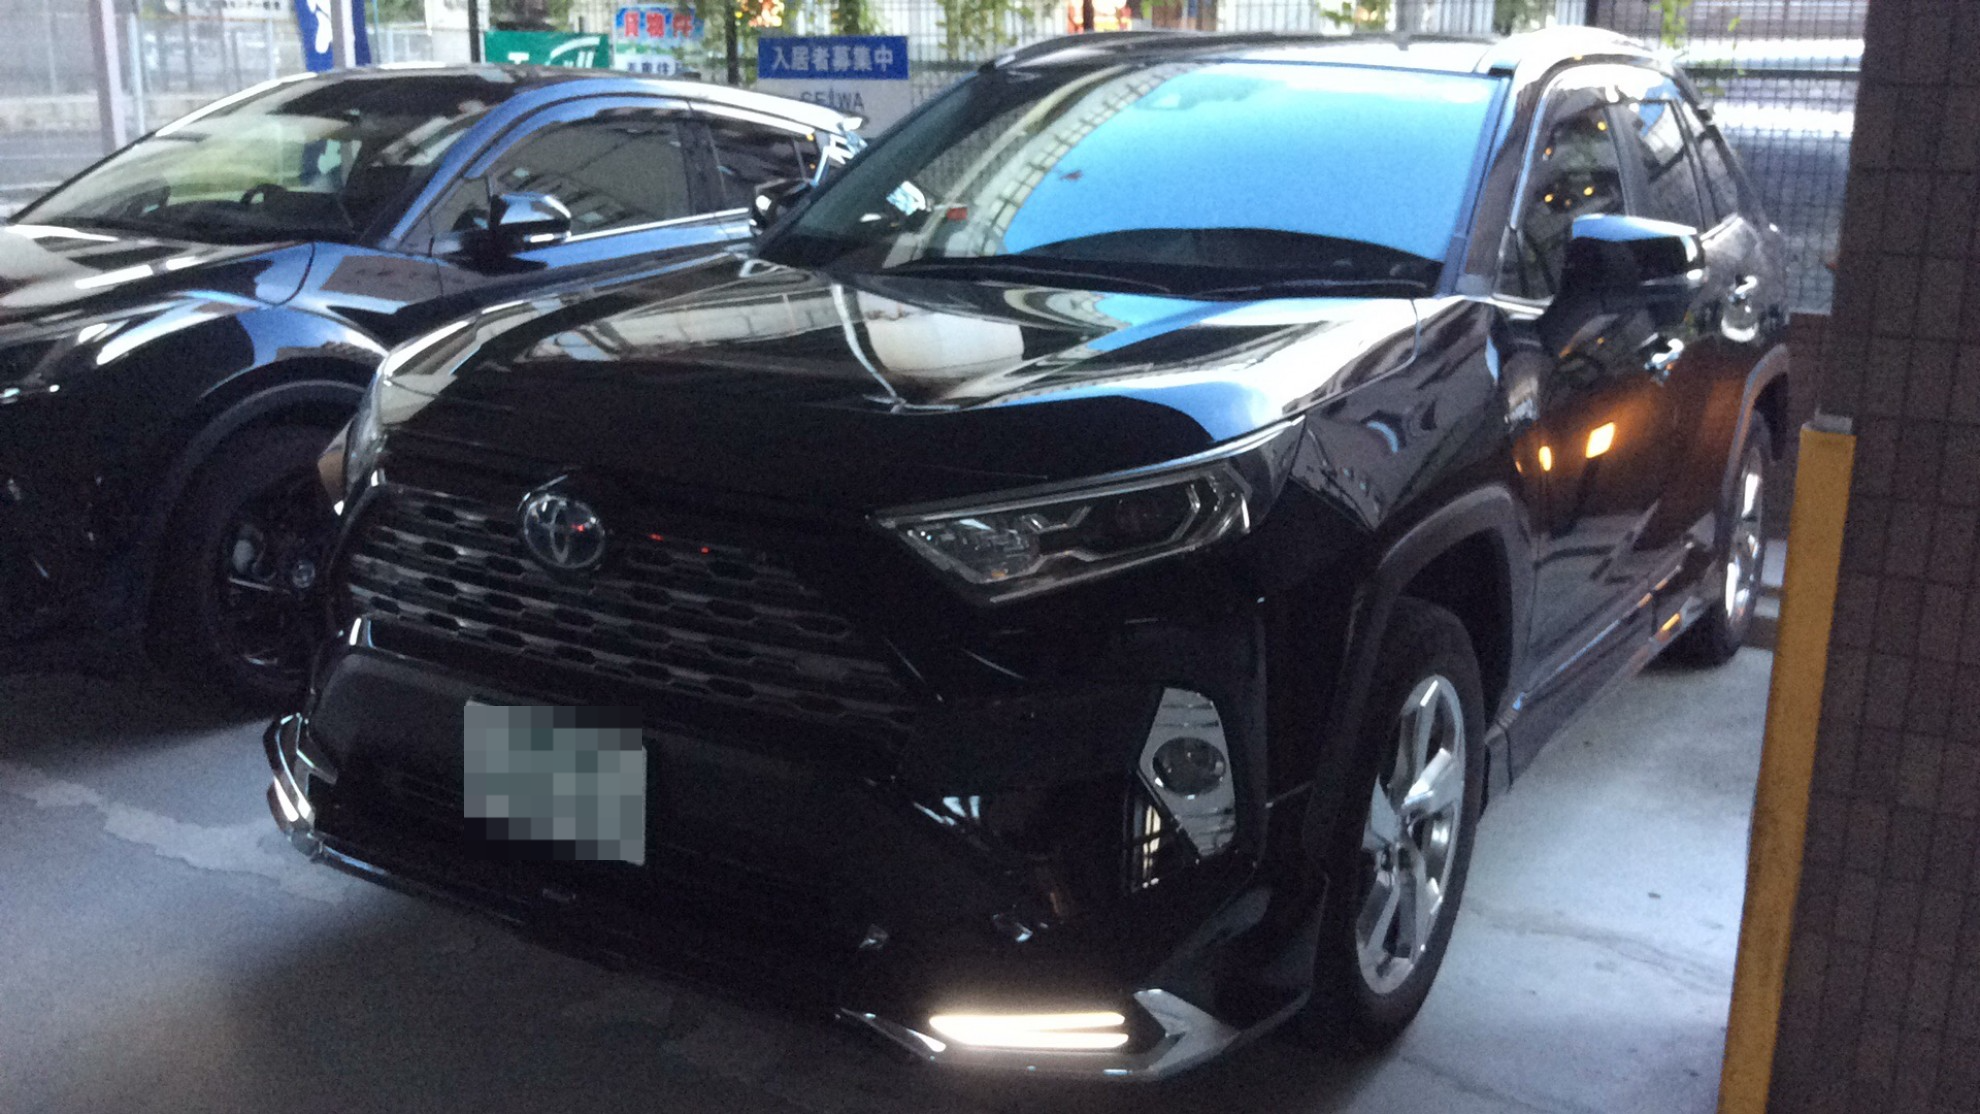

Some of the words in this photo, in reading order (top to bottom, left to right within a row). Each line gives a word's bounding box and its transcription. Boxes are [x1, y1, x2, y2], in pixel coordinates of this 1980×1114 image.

[771, 44, 894, 72] 入居者募集中
